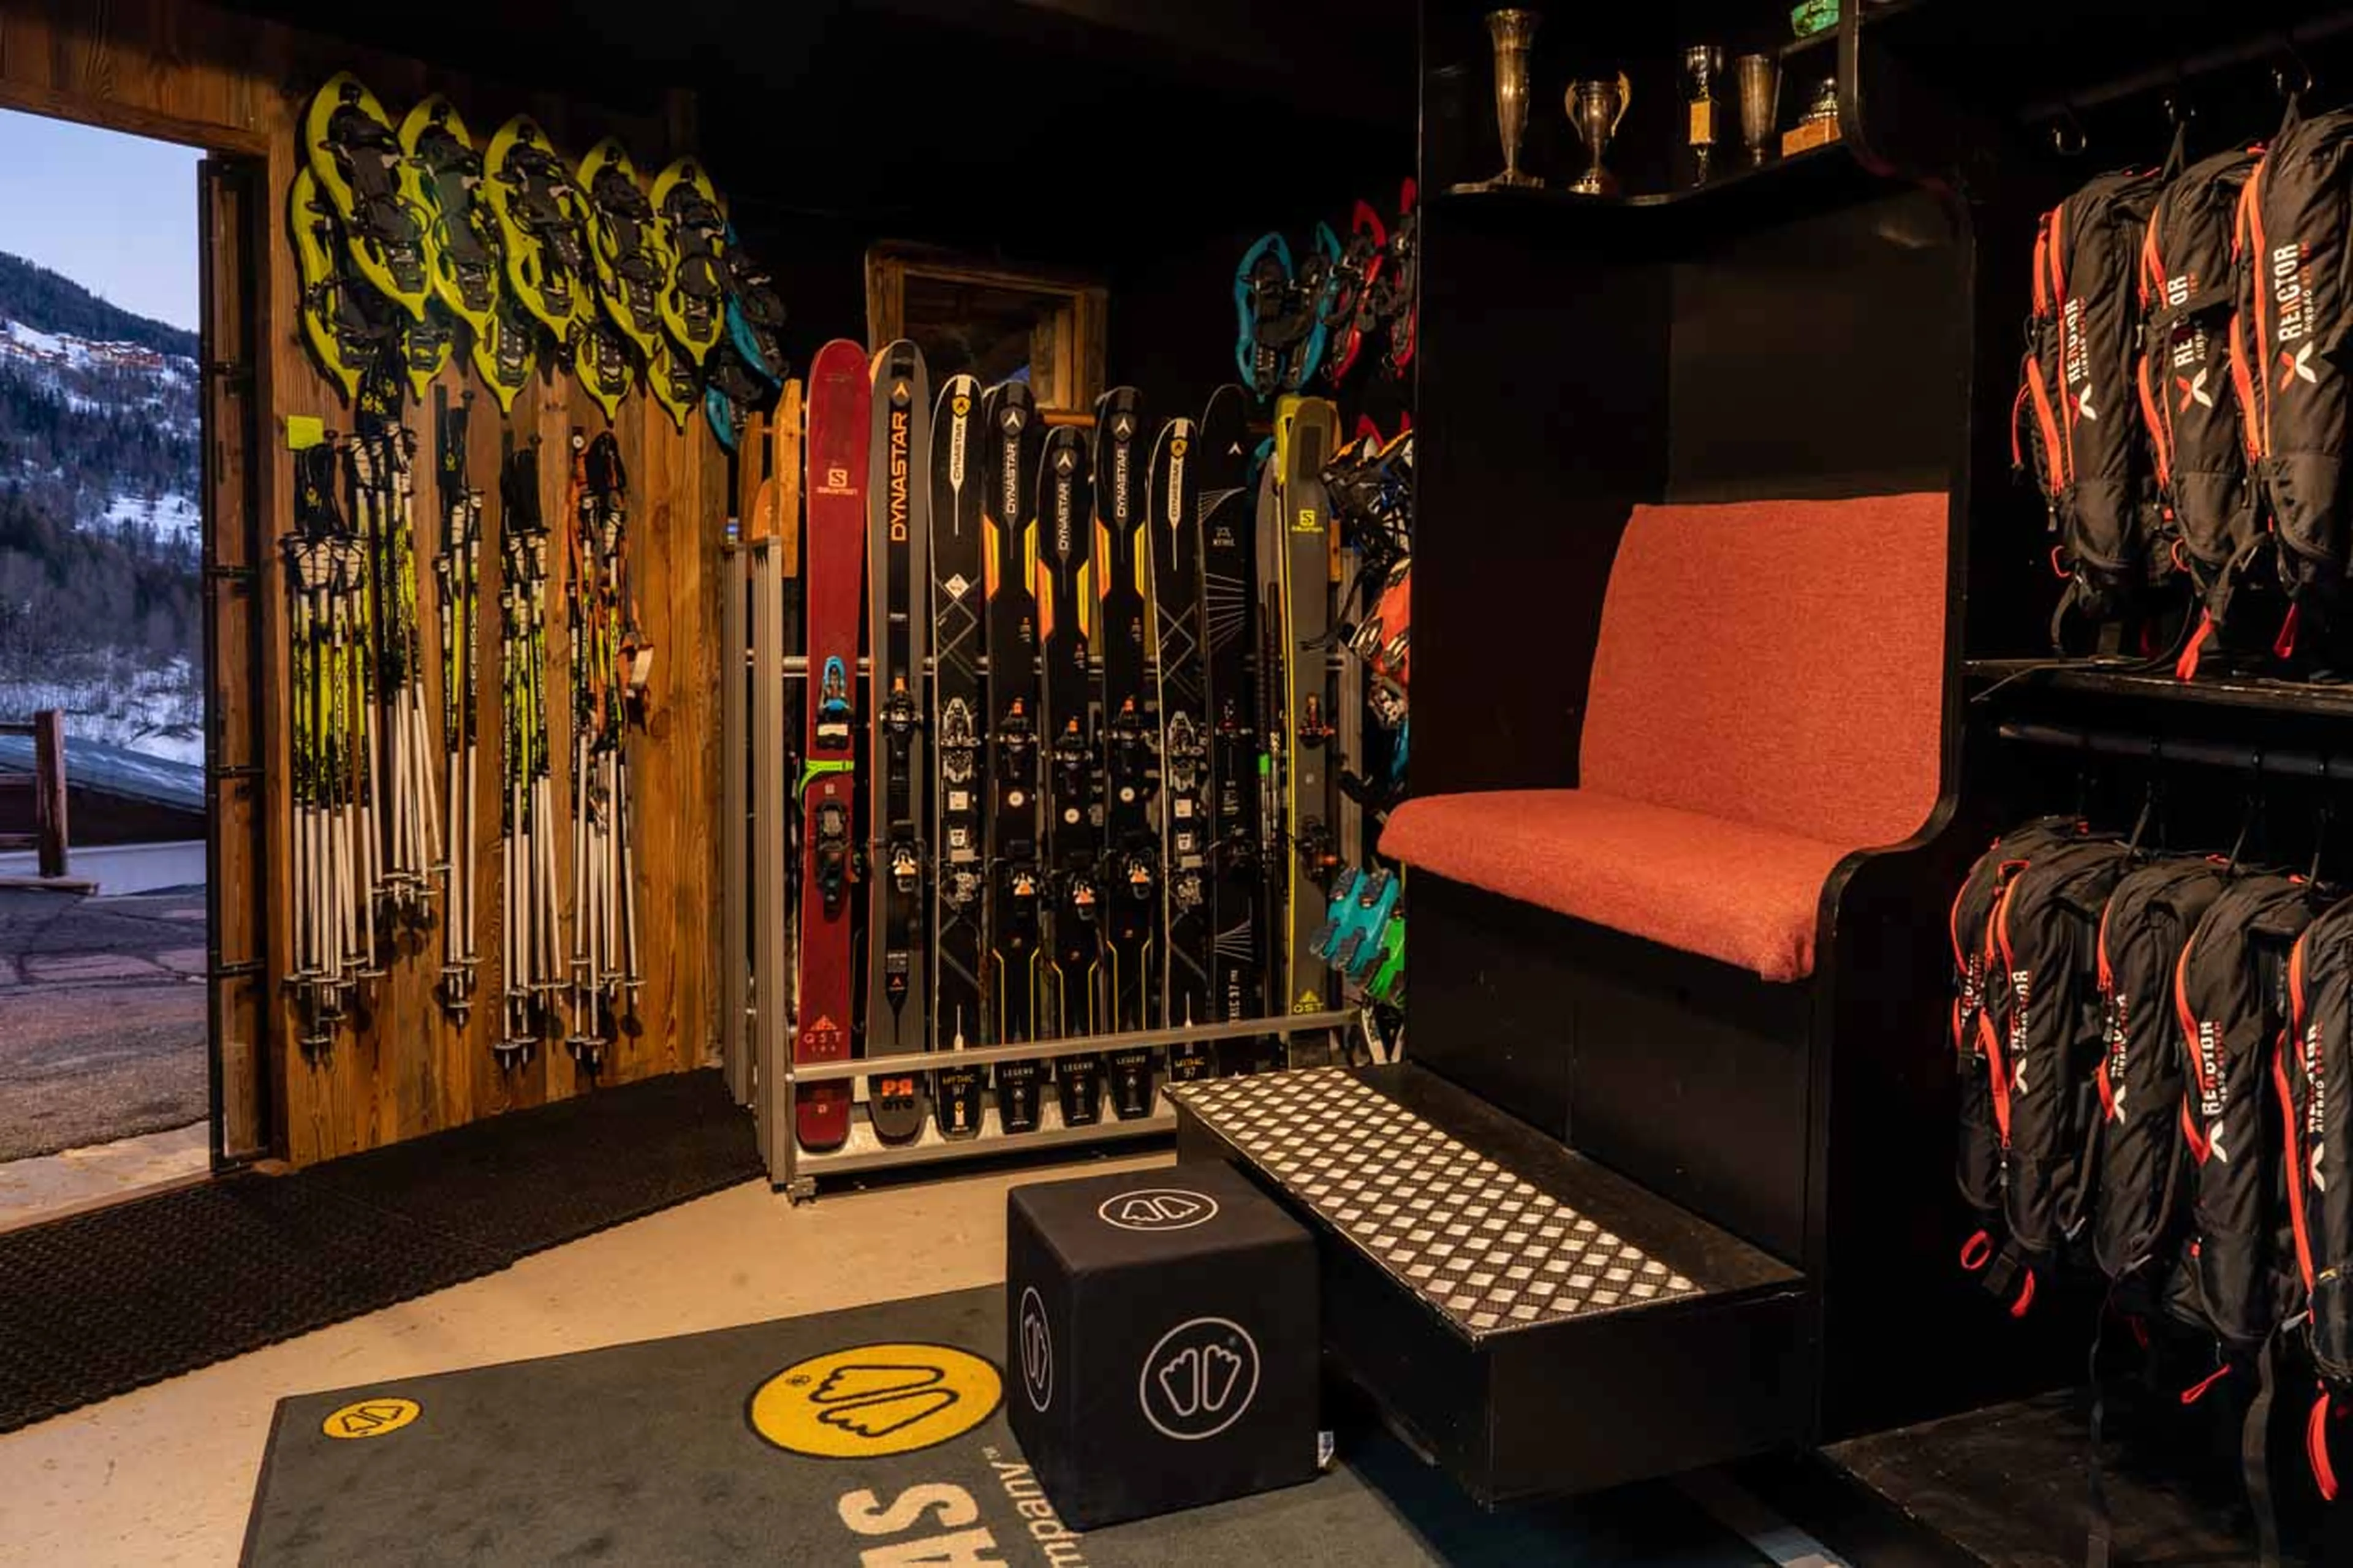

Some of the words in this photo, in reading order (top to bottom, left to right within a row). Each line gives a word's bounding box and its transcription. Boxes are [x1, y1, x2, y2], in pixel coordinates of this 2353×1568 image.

[2273, 244, 2303, 342] REACTOR
[890, 411, 907, 542] DYNASTAR
[1005, 442, 1016, 513] DYNASTAR
[1116, 449, 1127, 517] DYNASTAR
[1058, 482, 1070, 550] DYNASTAR
[803, 1031, 843, 1045] QST
